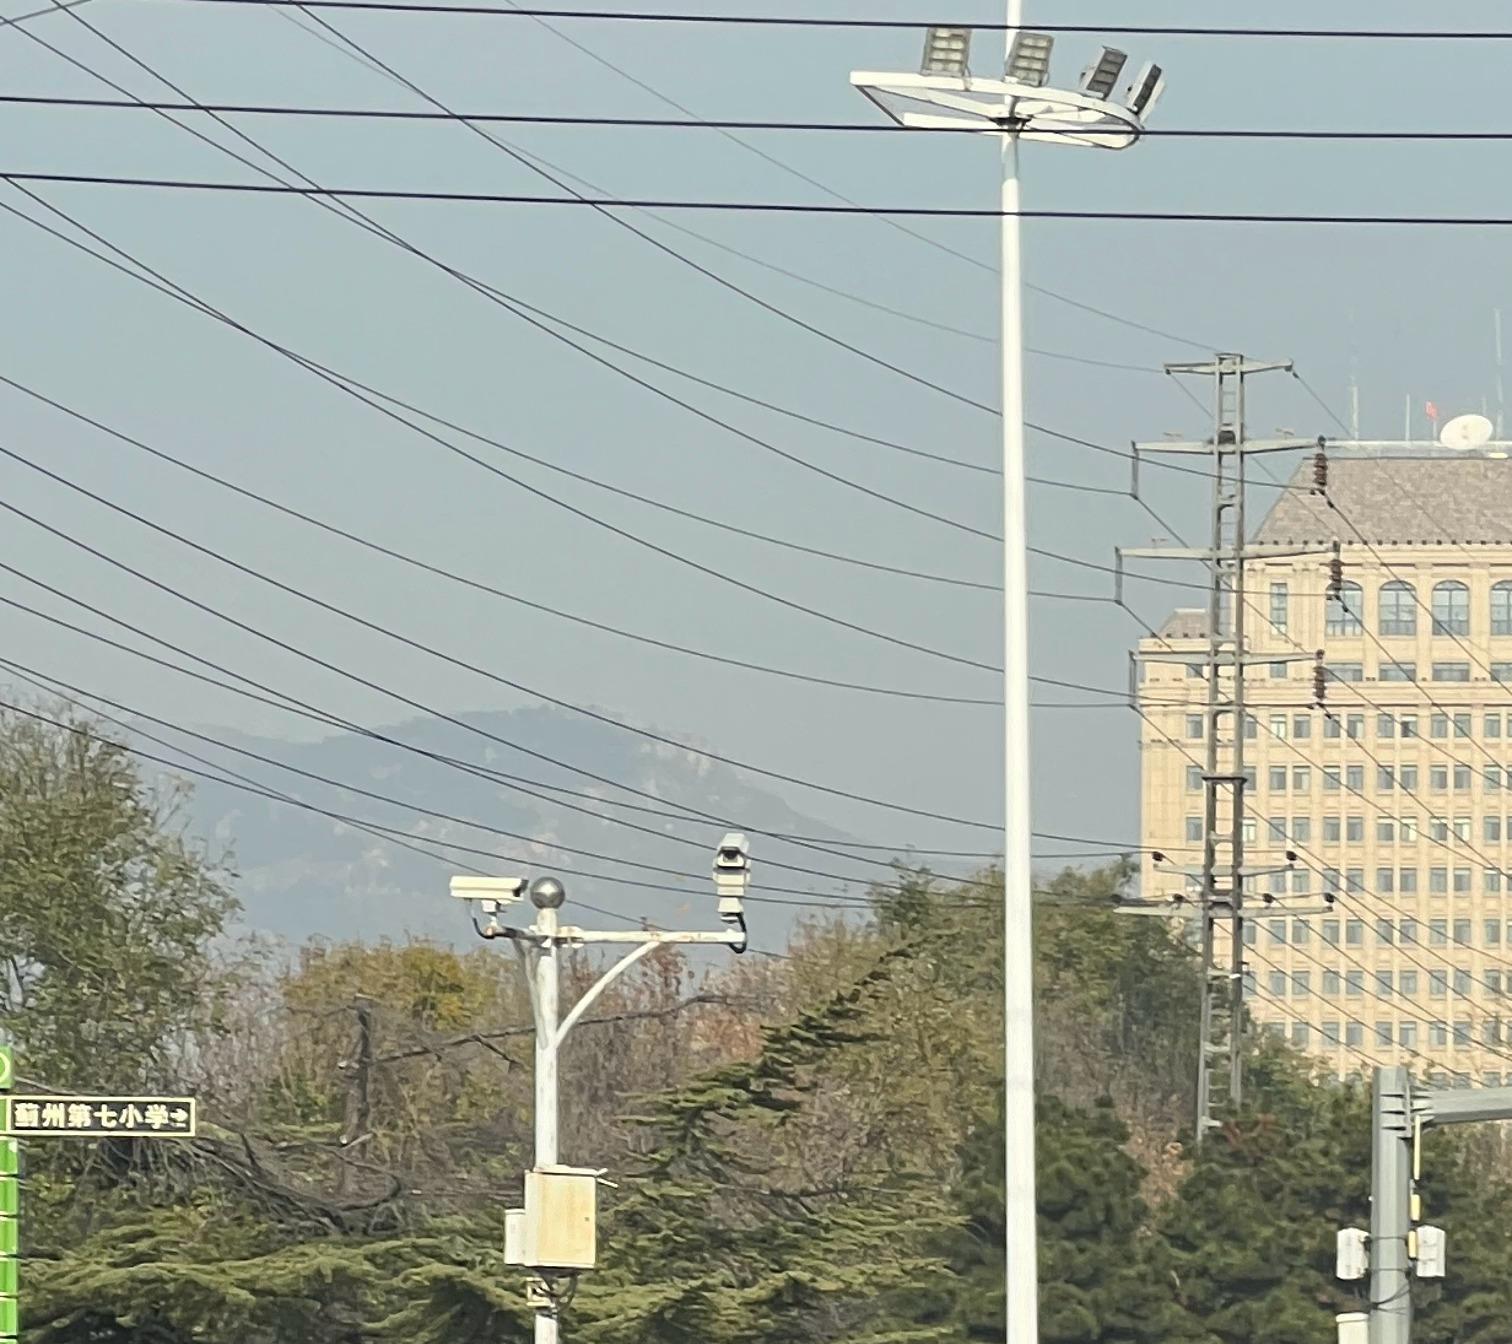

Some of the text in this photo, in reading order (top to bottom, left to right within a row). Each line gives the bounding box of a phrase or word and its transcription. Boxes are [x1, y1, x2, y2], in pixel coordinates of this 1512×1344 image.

[14, 1102, 170, 1130] 蓟州第七小学
